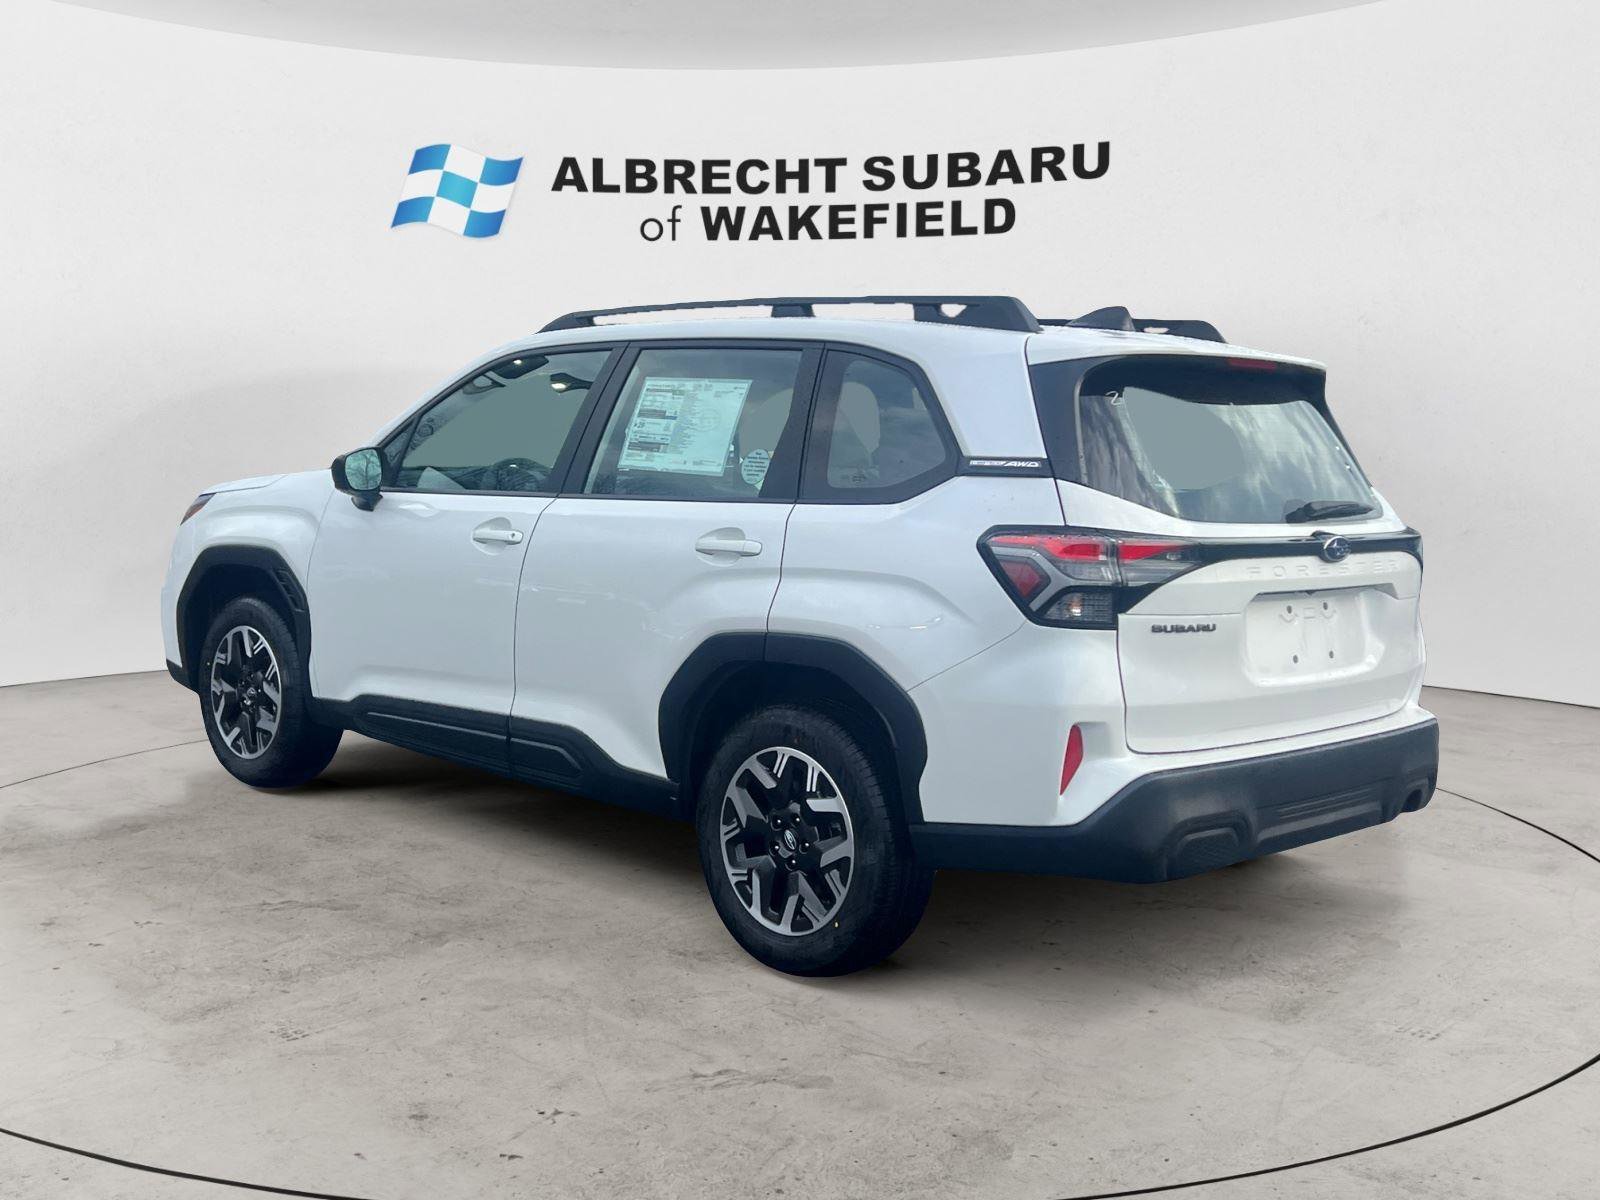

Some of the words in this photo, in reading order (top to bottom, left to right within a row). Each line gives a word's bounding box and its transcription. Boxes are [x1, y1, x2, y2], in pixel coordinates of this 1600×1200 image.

[551, 156, 848, 194] ALBRECHT
[862, 141, 1110, 192] SUBARU
[639, 204, 683, 242] of
[700, 197, 1016, 242] WAKEFIELD
[1003, 460, 1041, 468] AWD
[1150, 622, 1218, 634] SUBARU
